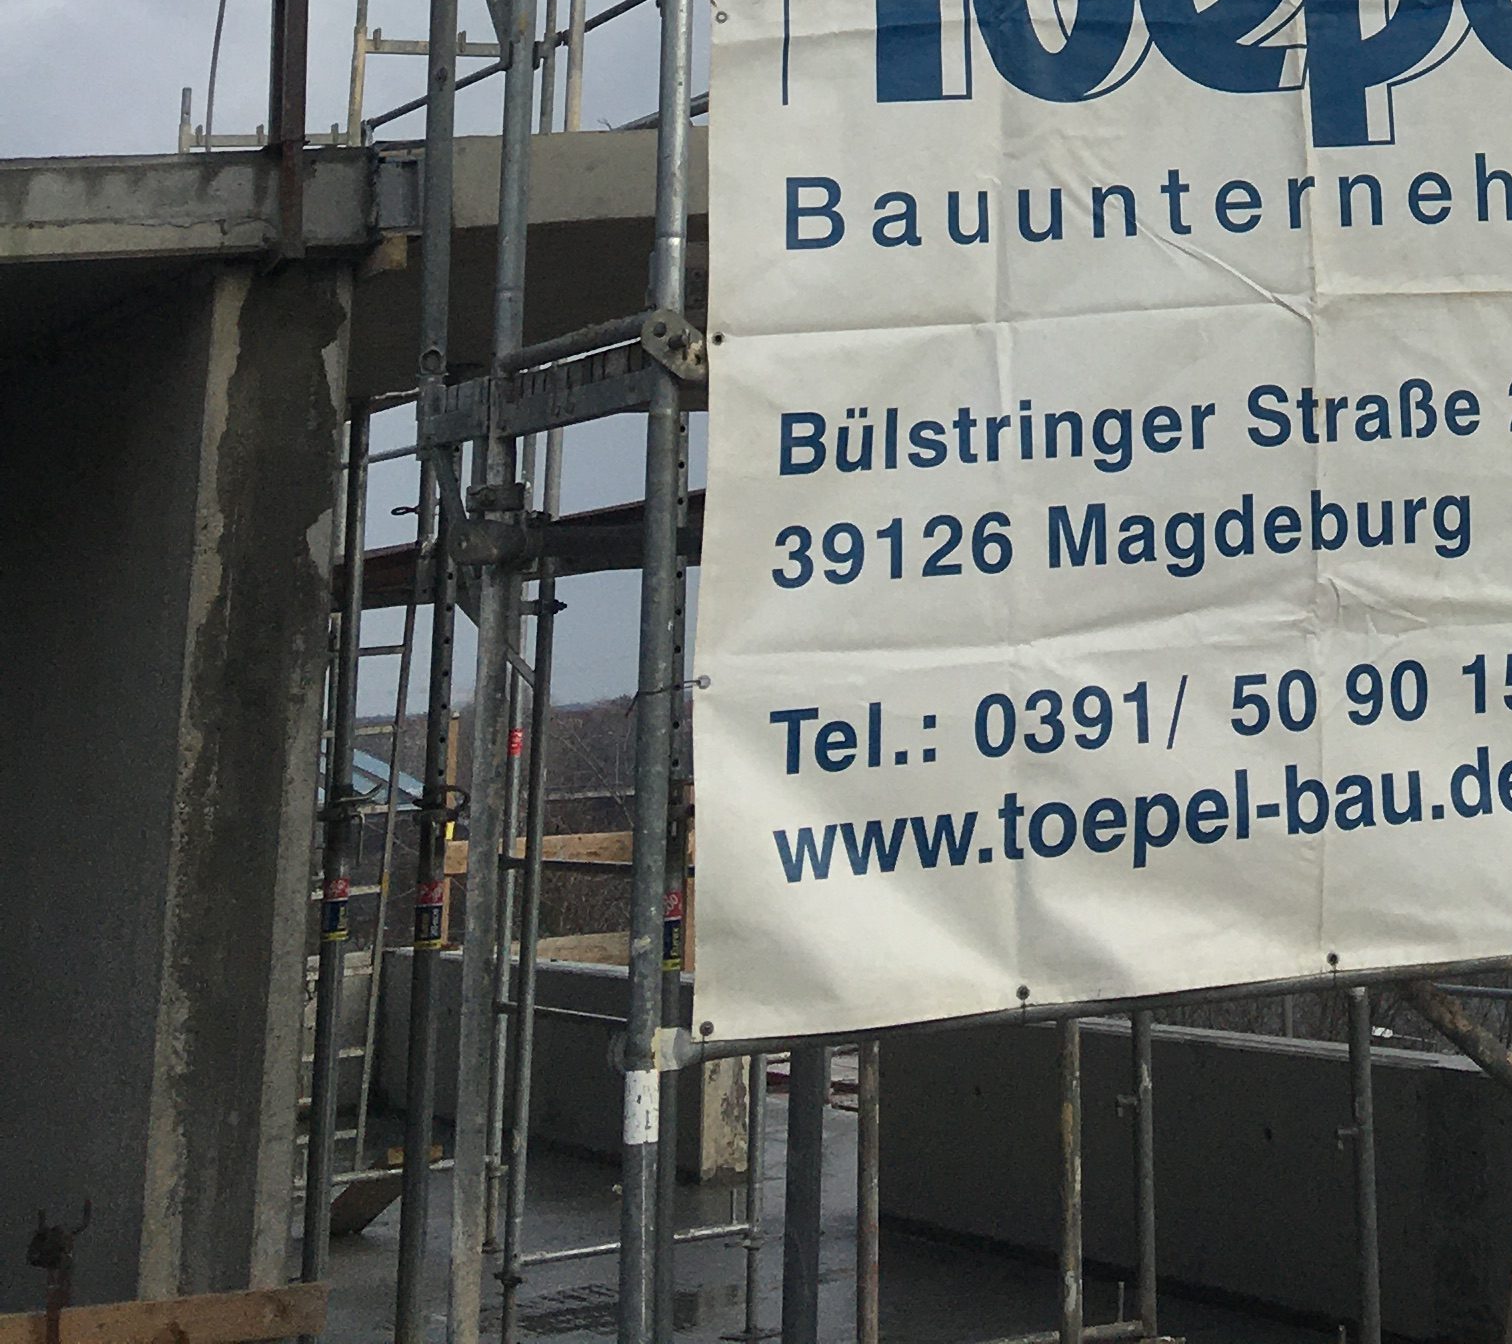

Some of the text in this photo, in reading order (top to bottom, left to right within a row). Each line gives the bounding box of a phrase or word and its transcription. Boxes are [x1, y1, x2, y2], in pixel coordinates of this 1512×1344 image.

[779, 400, 1216, 476] Bülstringer
[1247, 380, 1480, 447] Straße
[772, 491, 1471, 589] 39126 Magdeburg
[770, 704, 938, 775] Tel.:
[975, 674, 1188, 757] 0391/
[1231, 671, 1316, 736] 50
[1346, 660, 1429, 725] 90
